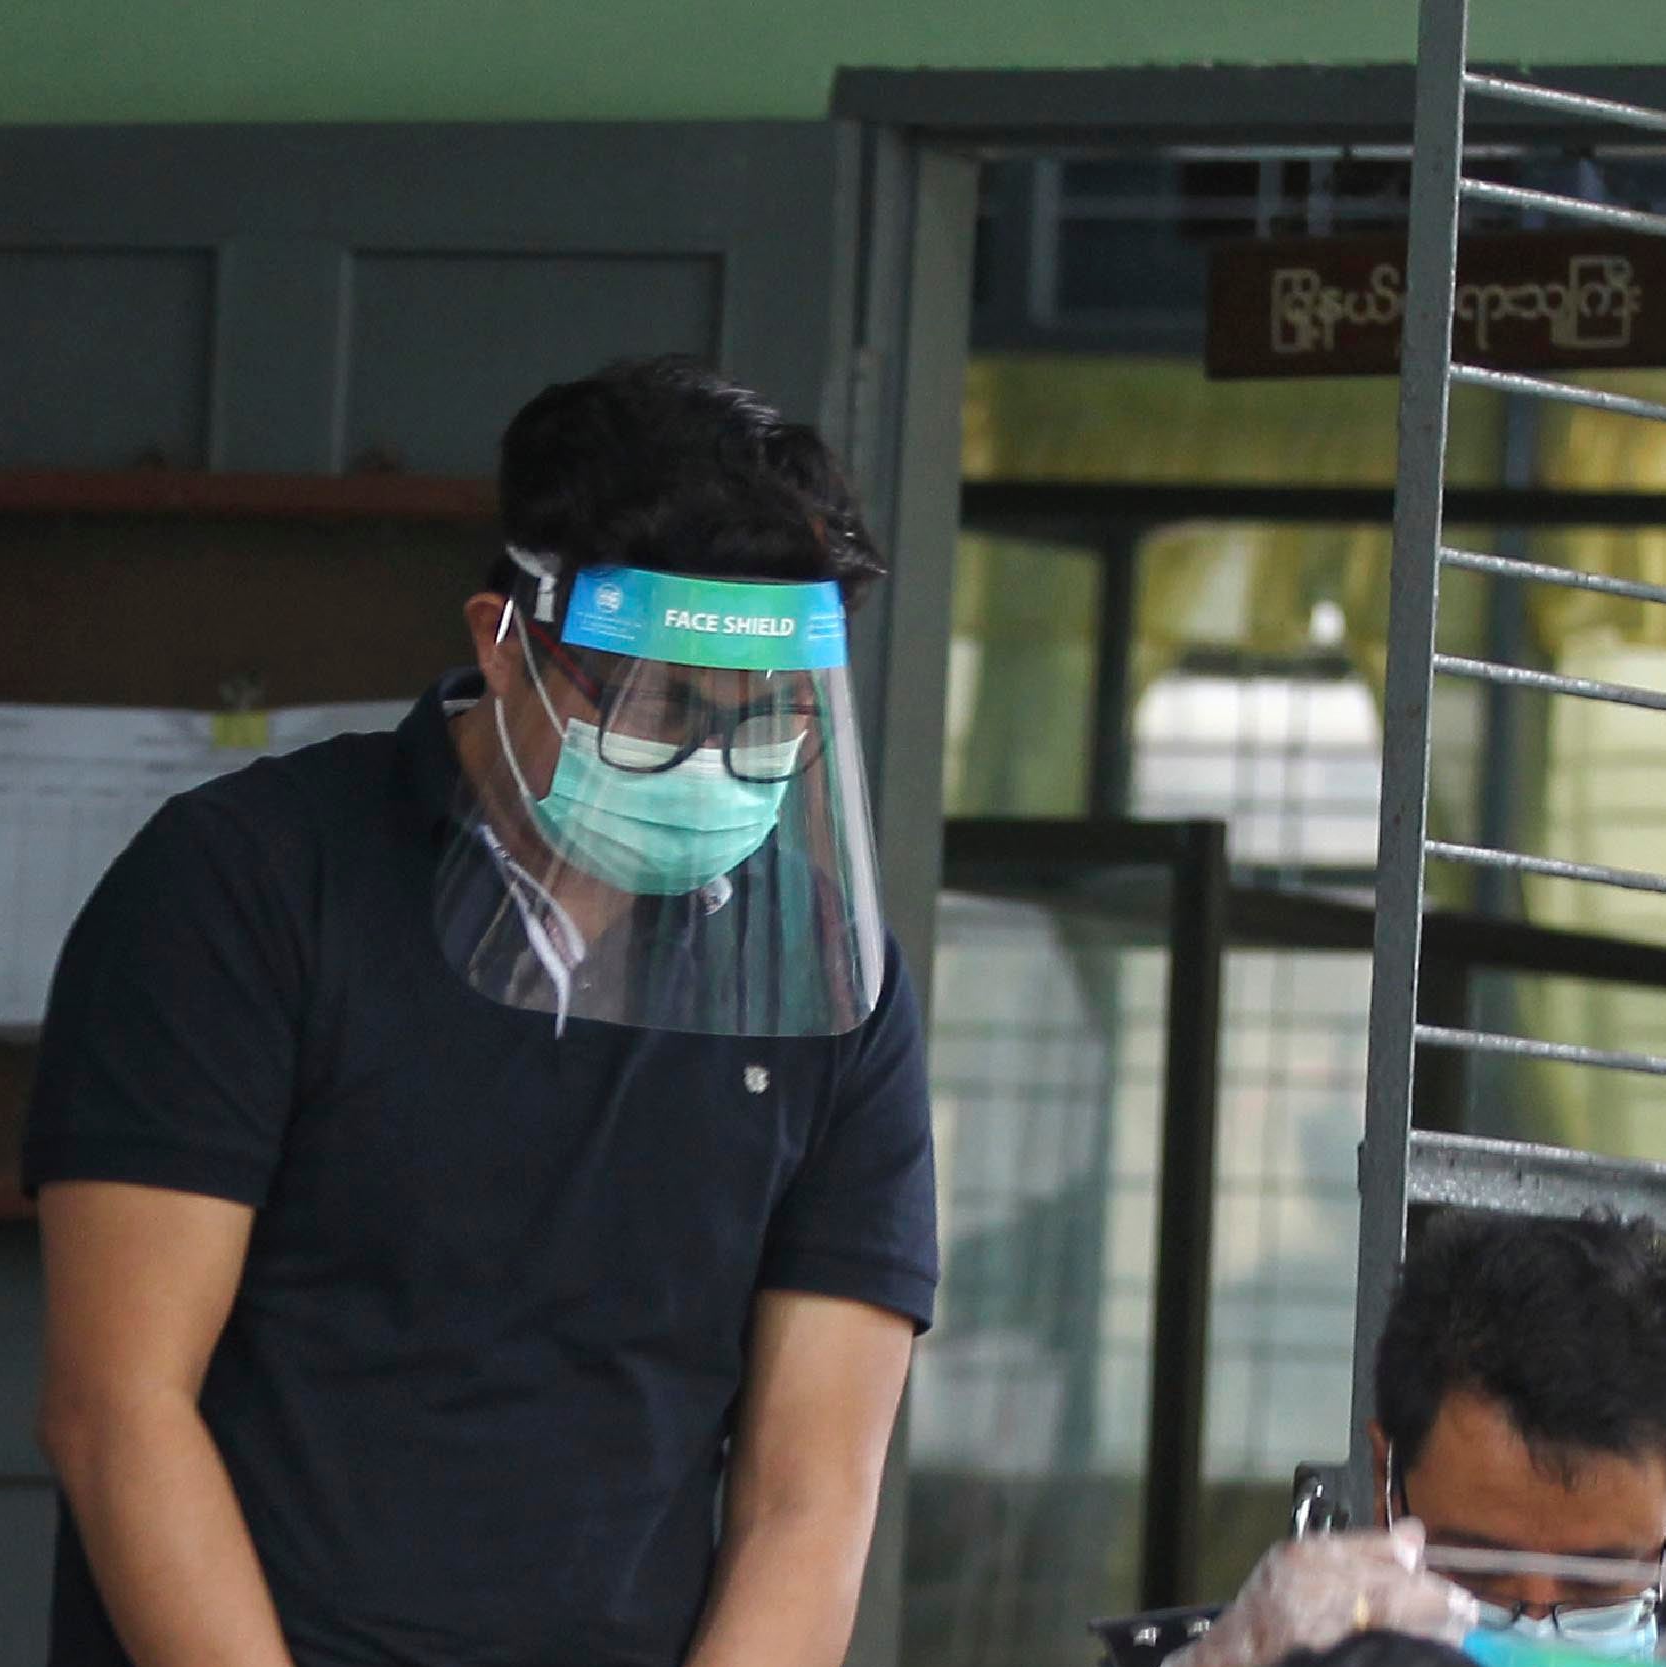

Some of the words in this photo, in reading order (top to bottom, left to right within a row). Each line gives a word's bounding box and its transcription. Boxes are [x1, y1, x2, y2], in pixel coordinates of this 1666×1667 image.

[1272, 255, 1643, 352] မြို့နယ်ရားသူကြီး
[664, 608, 720, 633] FACE
[722, 615, 796, 638] SHIELD
